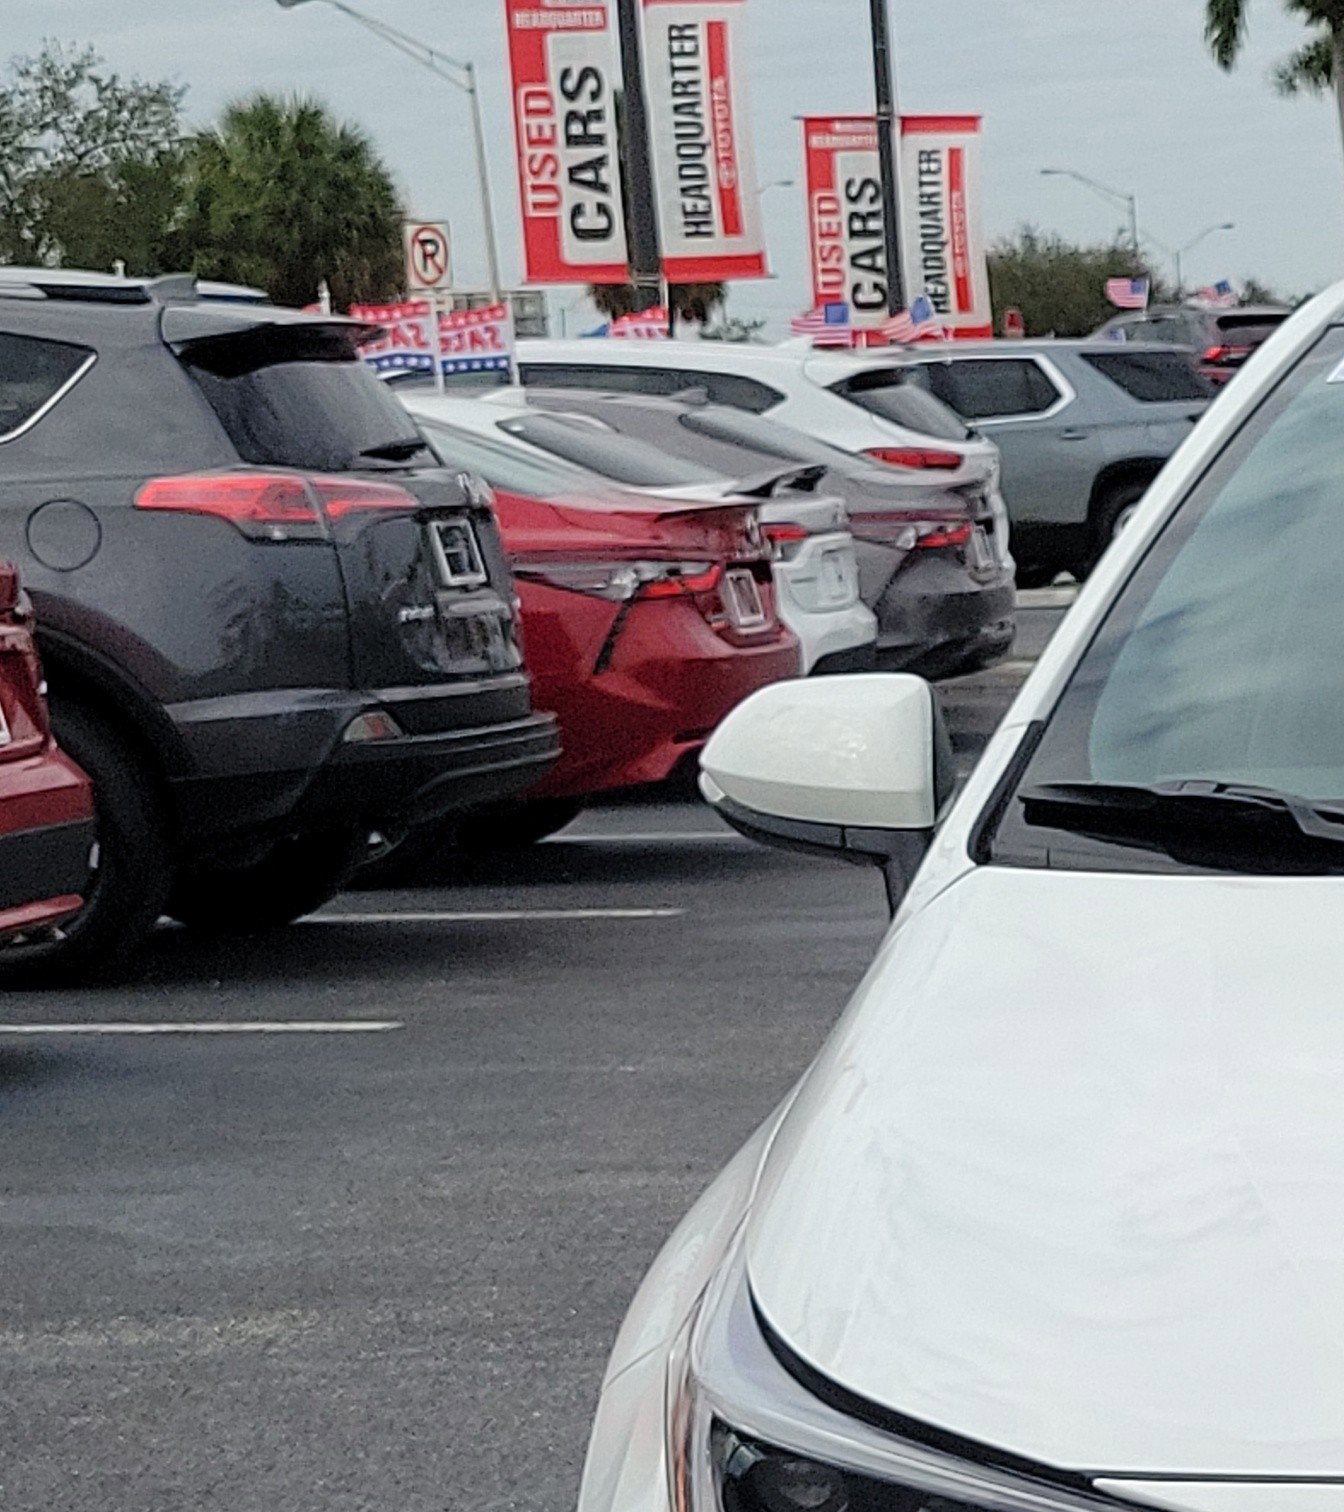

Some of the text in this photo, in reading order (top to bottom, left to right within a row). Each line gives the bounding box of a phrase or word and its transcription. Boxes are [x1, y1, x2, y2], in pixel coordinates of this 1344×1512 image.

[525, 91, 560, 210] USED
[560, 66, 613, 241] CARS
[668, 23, 714, 238] HEADQUARTER
[817, 195, 844, 288] USED
[845, 178, 887, 310] CARS
